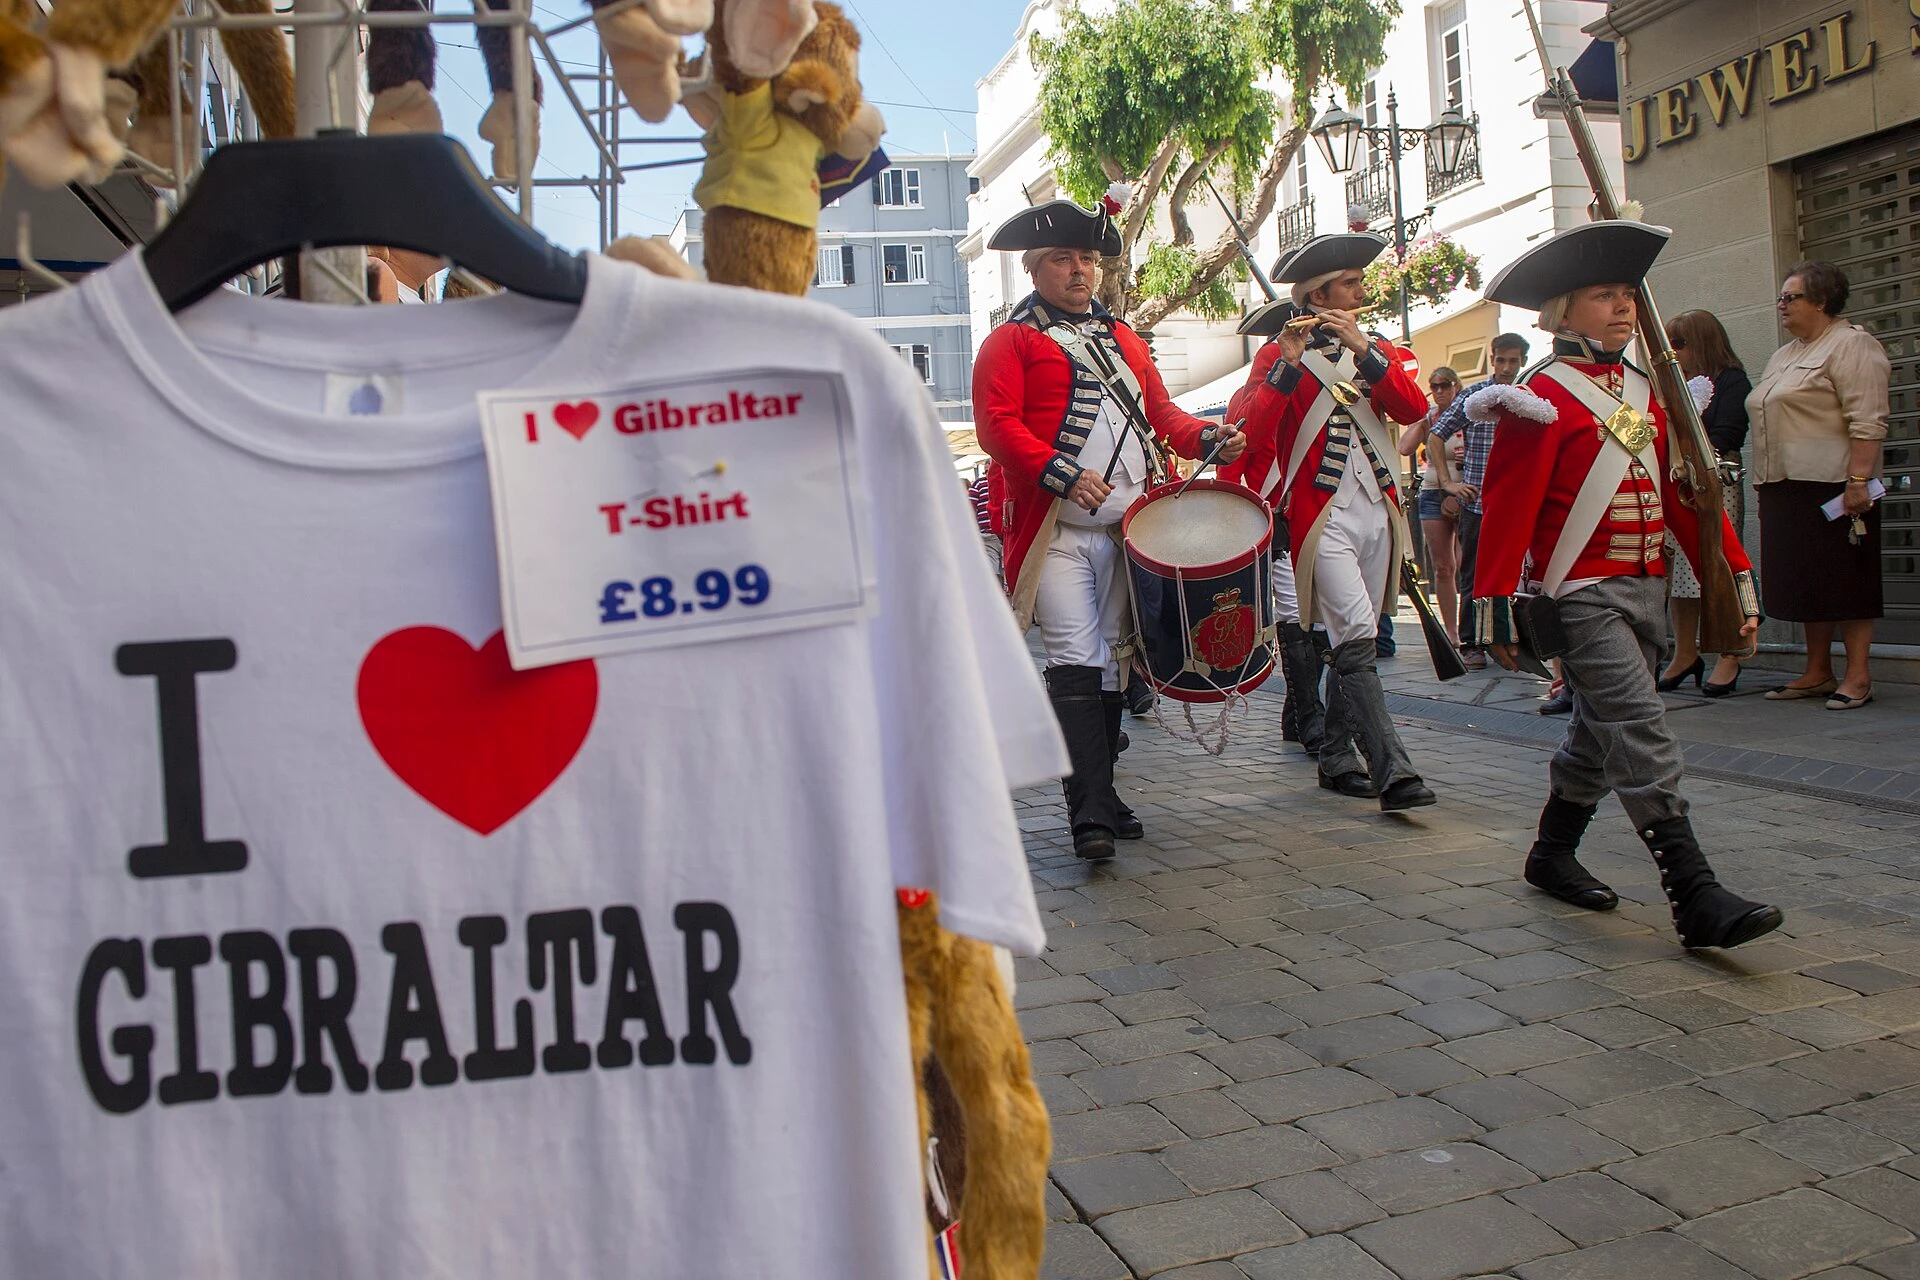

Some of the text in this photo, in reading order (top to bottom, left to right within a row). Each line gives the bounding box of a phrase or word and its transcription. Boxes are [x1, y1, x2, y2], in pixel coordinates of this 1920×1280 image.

[1621, 10, 1876, 163] JEWEL
[523, 391, 802, 445] I Gibraltar
[598, 491, 750, 535] T-Shirt
[599, 564, 770, 624] £8.99
[114, 638, 250, 880] I
[76, 901, 753, 1116] GIBRALTAR
